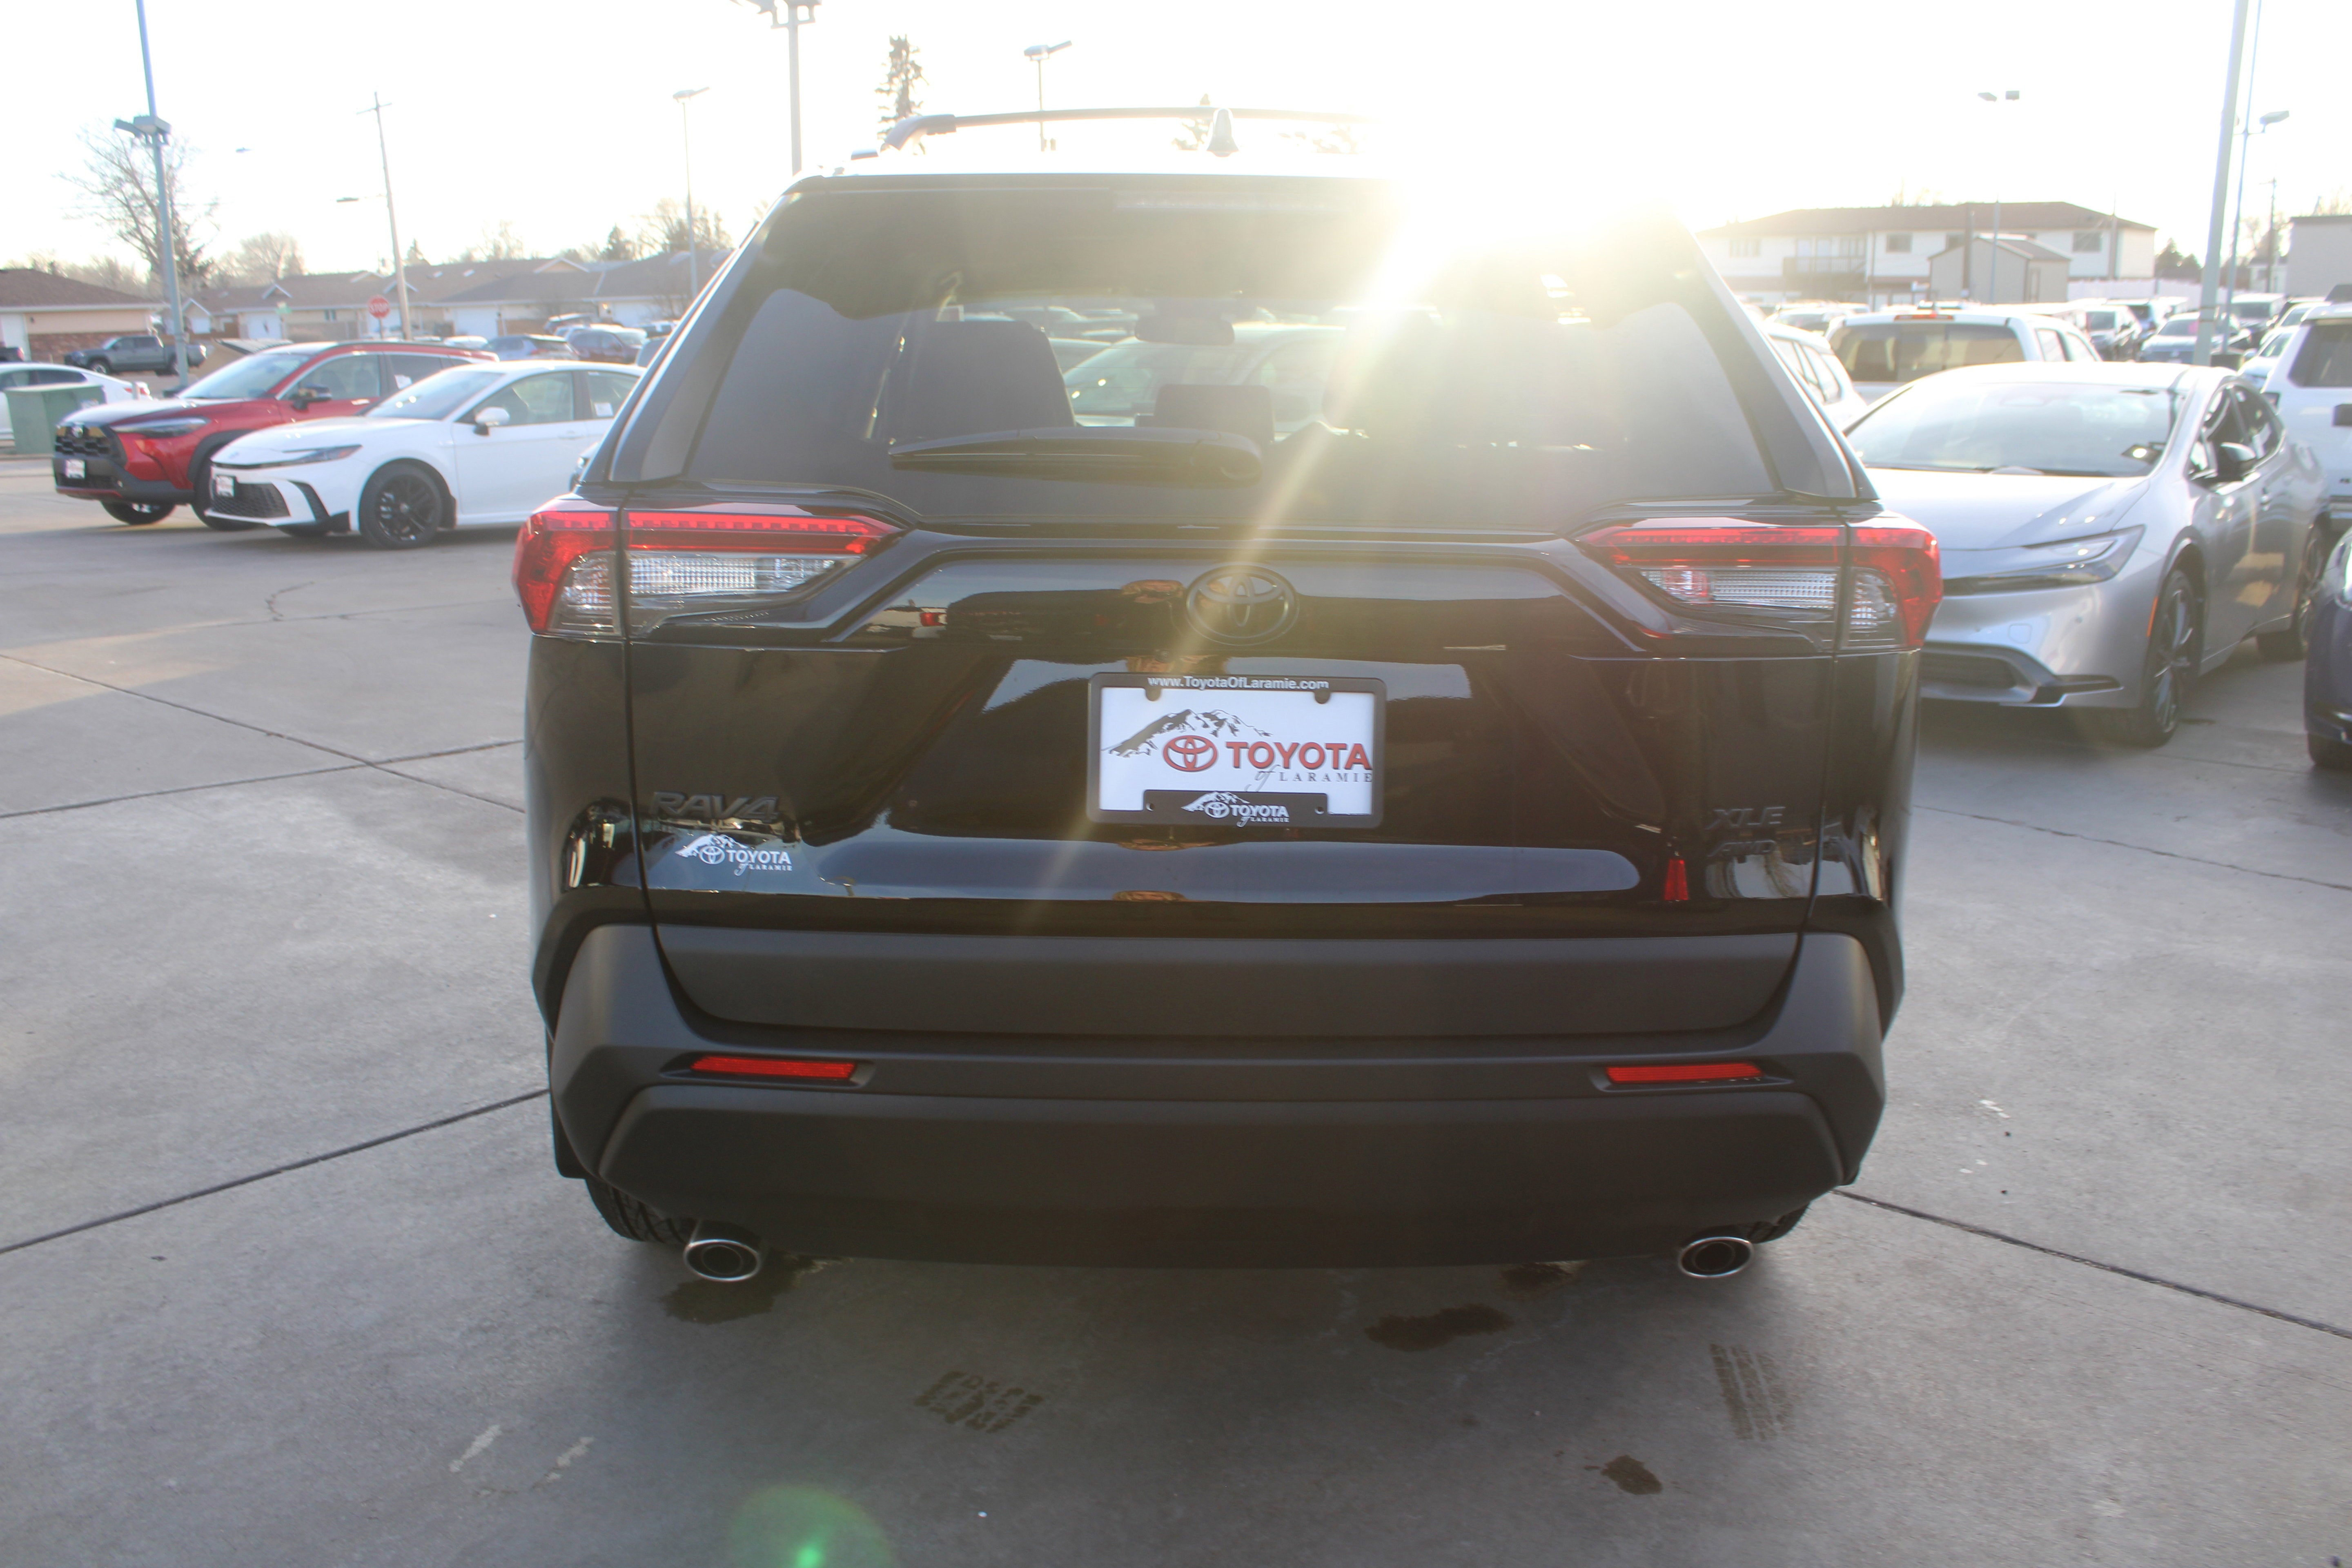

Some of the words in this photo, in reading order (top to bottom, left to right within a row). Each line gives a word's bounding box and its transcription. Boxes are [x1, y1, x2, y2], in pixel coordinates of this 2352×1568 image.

[1147, 676, 1330, 690] www.ToyotaOfLaramie.com
[1226, 741, 1372, 770] TOYOTA
[1278, 771, 1372, 783] LARAMIE
[653, 791, 779, 822] RAV4
[1229, 804, 1290, 817] TOYOTA
[1704, 806, 1786, 830] XLE
[726, 849, 792, 864] TOYOTA
